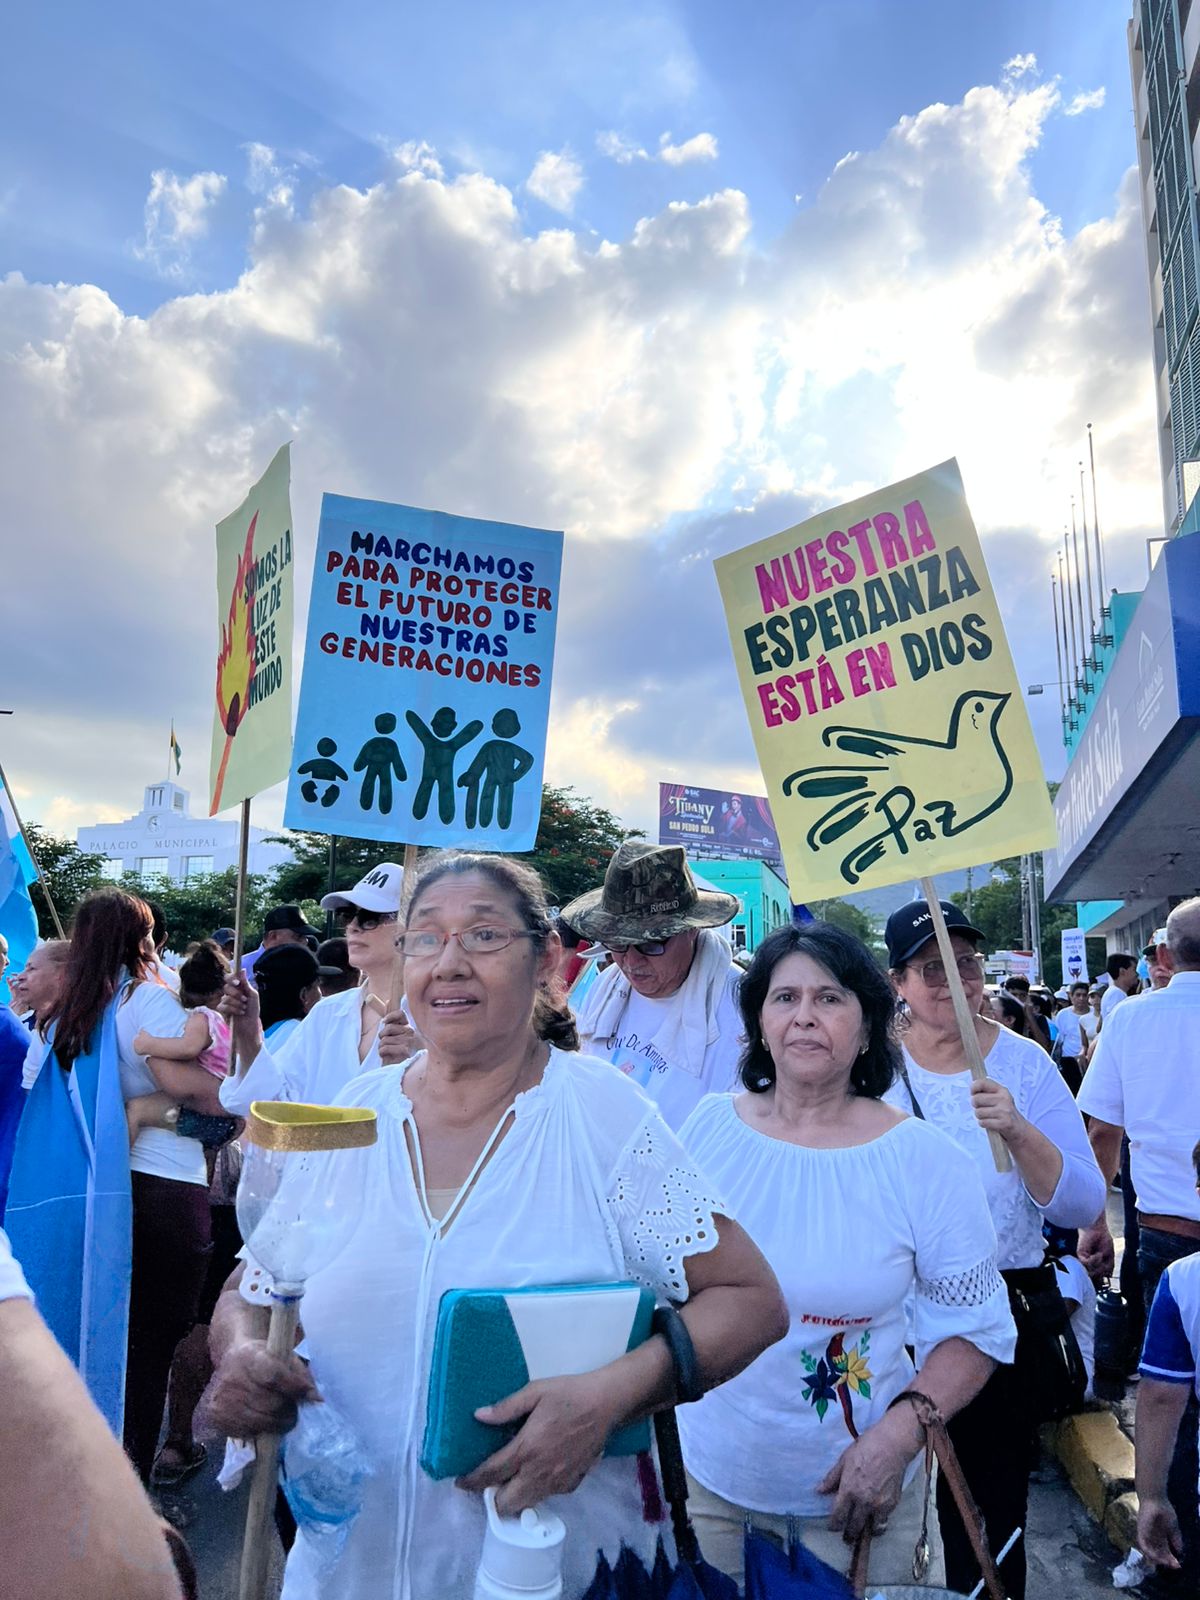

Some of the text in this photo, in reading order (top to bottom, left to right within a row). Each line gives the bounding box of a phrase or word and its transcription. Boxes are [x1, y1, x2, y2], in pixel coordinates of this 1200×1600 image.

[244, 529, 292, 604] SOMOS LA
[326, 552, 553, 611] PARA PROTEGER
[351, 531, 534, 583] MARCHAMOS
[755, 500, 936, 614] NUESTRA
[251, 577, 282, 634] LUZ DE
[336, 582, 537, 634] EL FUTURO DE
[744, 545, 981, 675] ESPERANZA
[255, 620, 276, 666] ESTE
[320, 632, 541, 688] GENERACIONES
[360, 613, 508, 657] NUESTRAS
[248, 655, 282, 710] MUNDO
[757, 613, 993, 728] ESTÁ EN DIOS
[1070, 735, 1096, 845] Hotel
[1094, 694, 1124, 807] Sula
[90, 838, 218, 850] PALACIO MUNICIPAL
[874, 785, 962, 855] Paz
